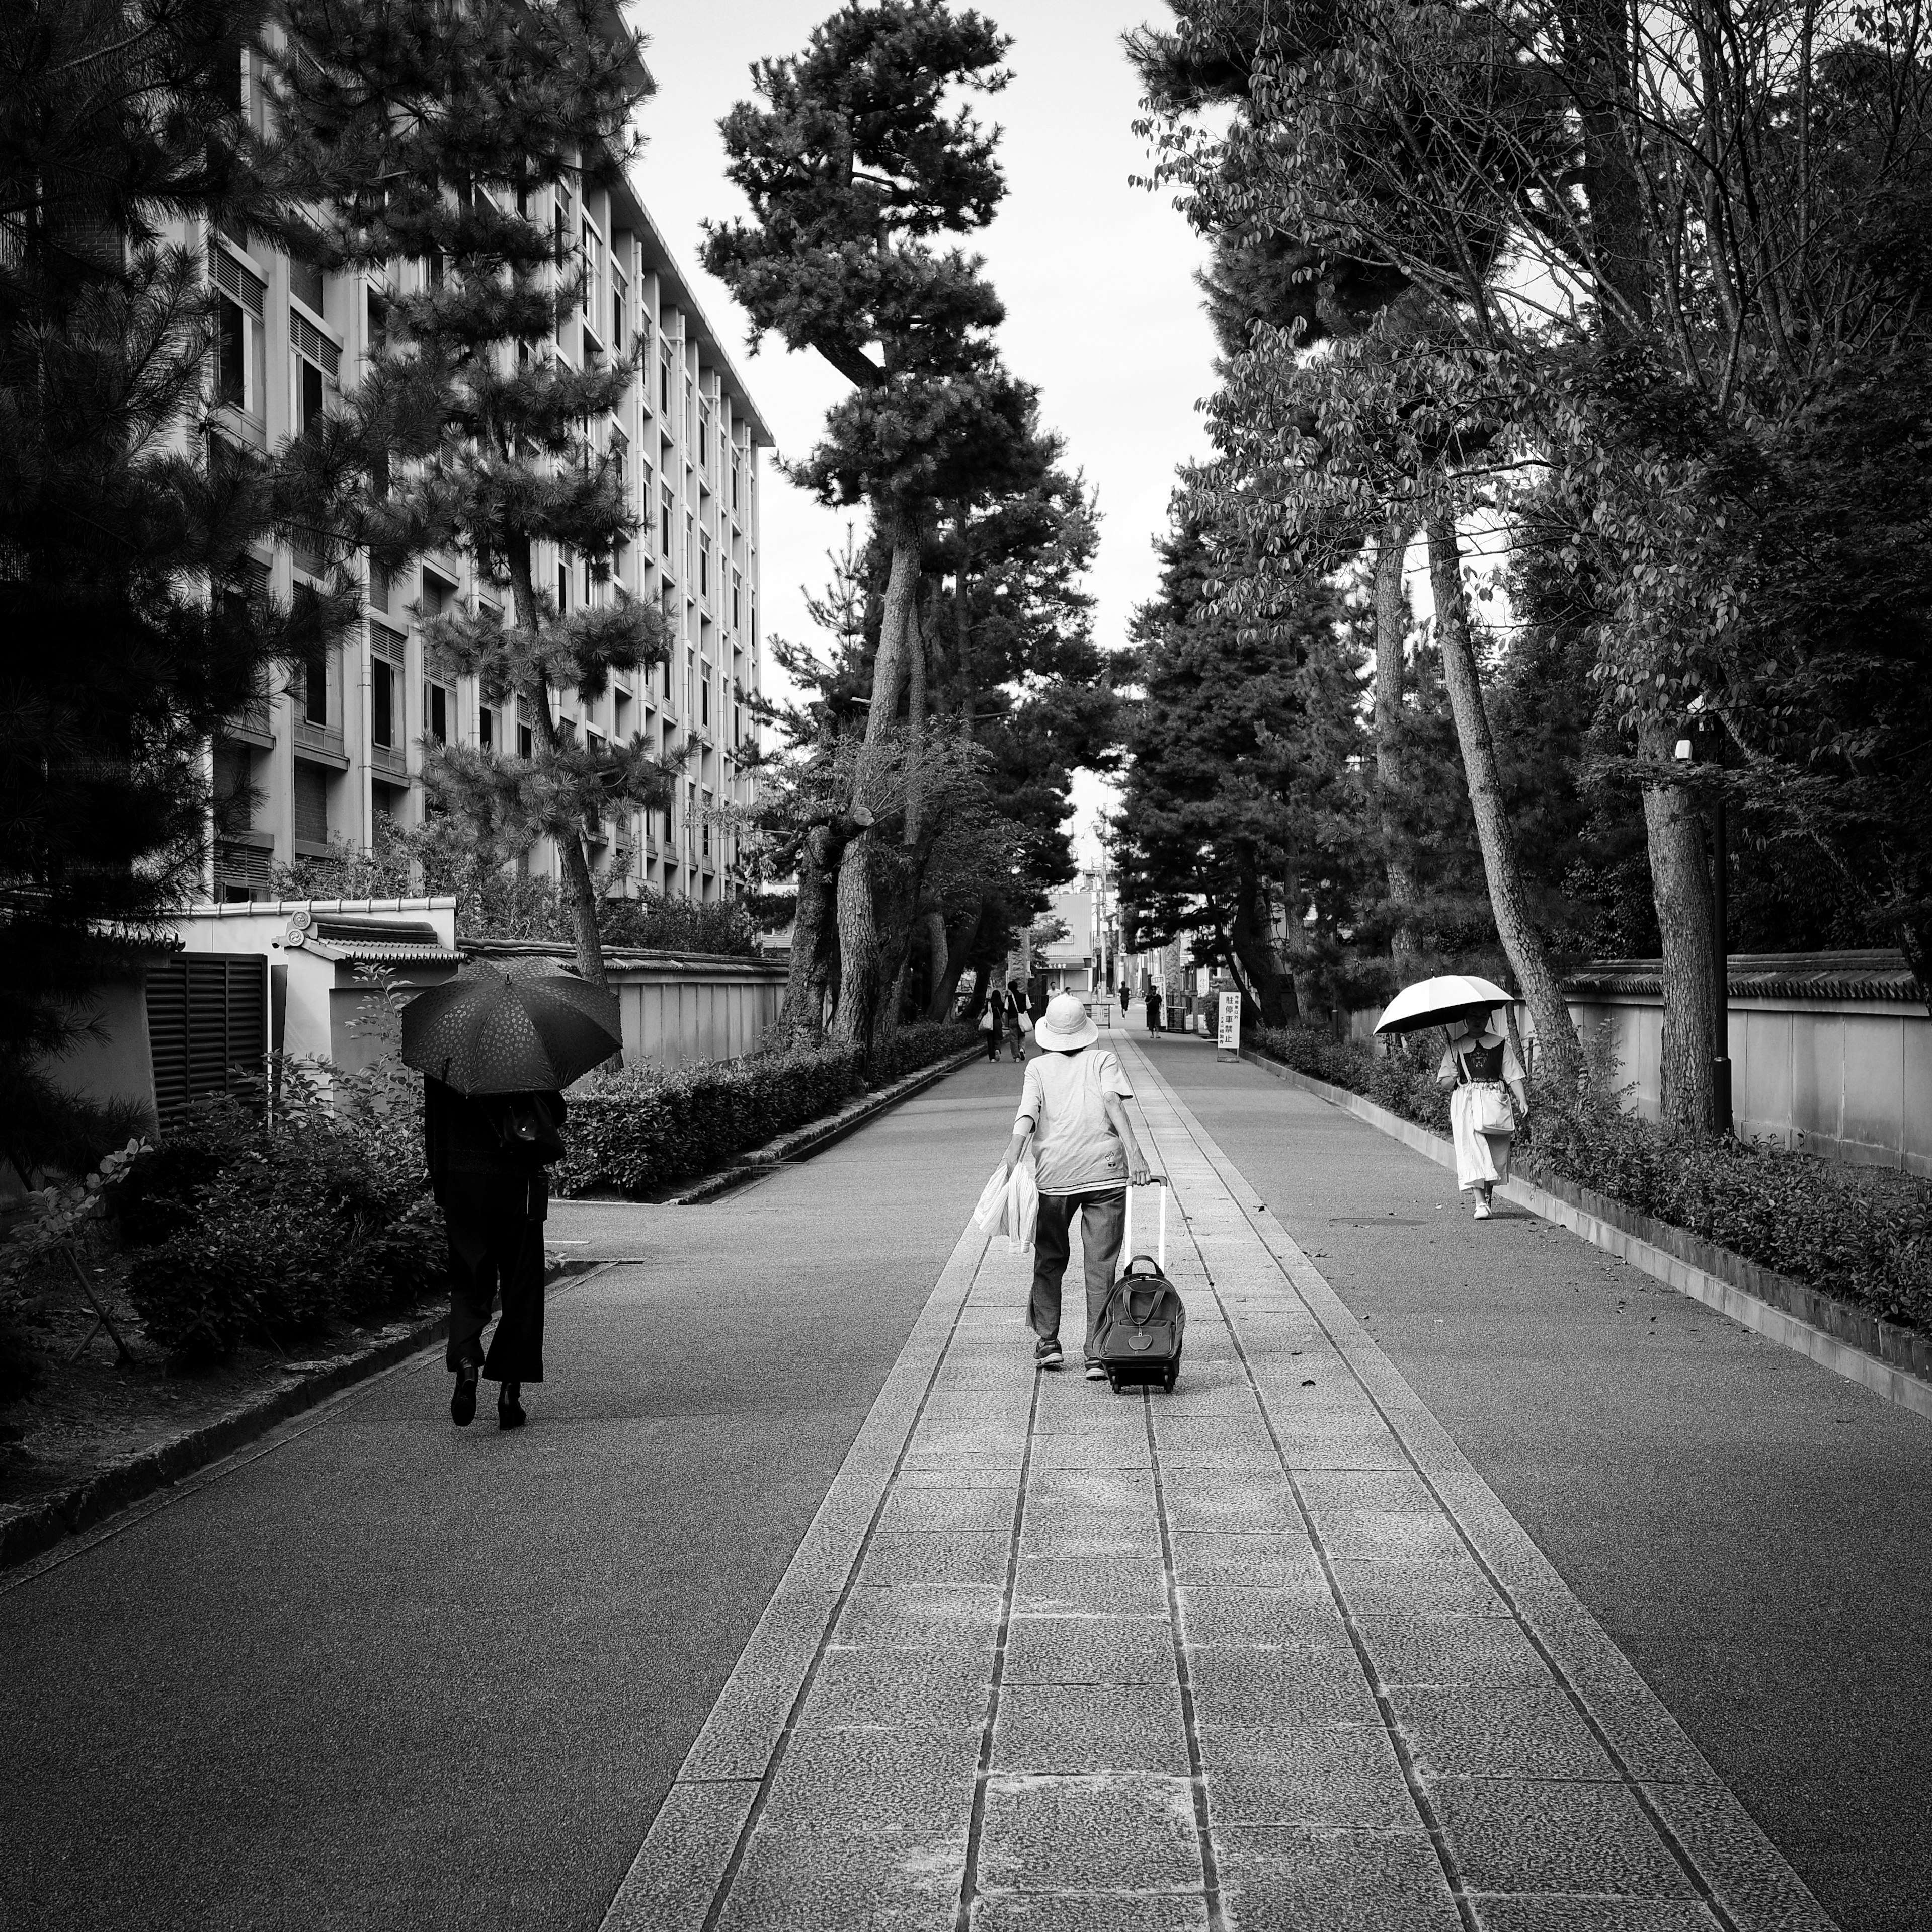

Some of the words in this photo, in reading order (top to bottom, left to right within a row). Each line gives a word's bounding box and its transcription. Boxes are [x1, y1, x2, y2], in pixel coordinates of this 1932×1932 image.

[1225, 996, 1234, 1043] 駐停車禁止
